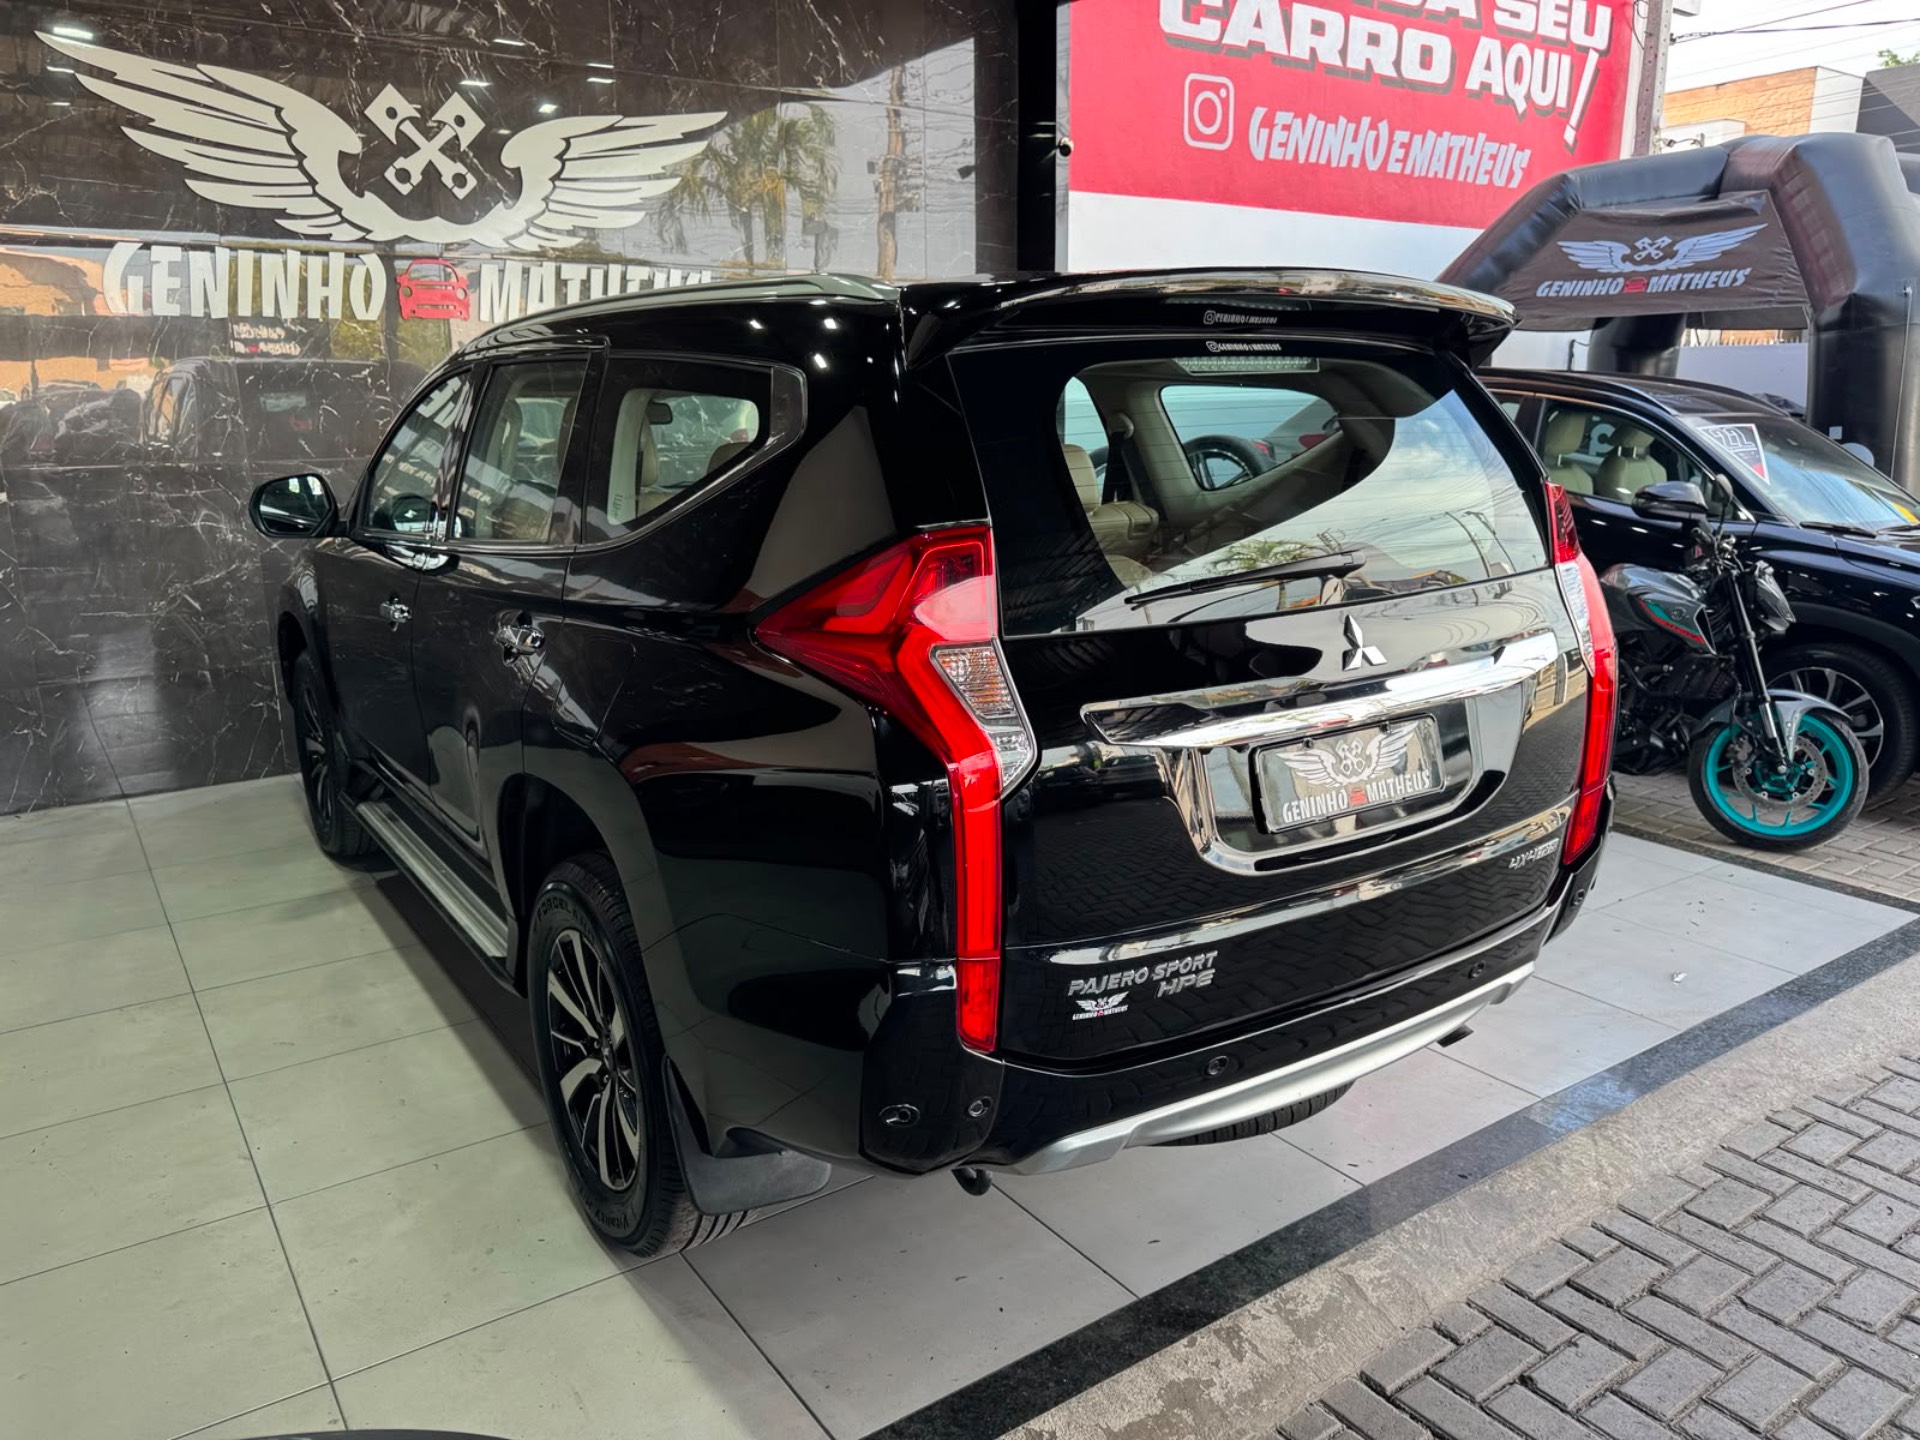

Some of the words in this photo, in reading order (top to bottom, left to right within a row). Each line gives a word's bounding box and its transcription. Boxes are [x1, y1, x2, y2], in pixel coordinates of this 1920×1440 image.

[1159, 0, 1453, 85] CARRO
[102, 241, 388, 321] GENINHO
[1536, 277, 1625, 298] GENINHO
[1646, 267, 1752, 294] MATHEUS
[1281, 789, 1349, 824] GENINHO
[1365, 768, 1431, 804] MATHEUS
[1067, 966, 1150, 996] PAJERO
[1152, 950, 1219, 981] SPORT
[1156, 968, 1216, 998] HPE
